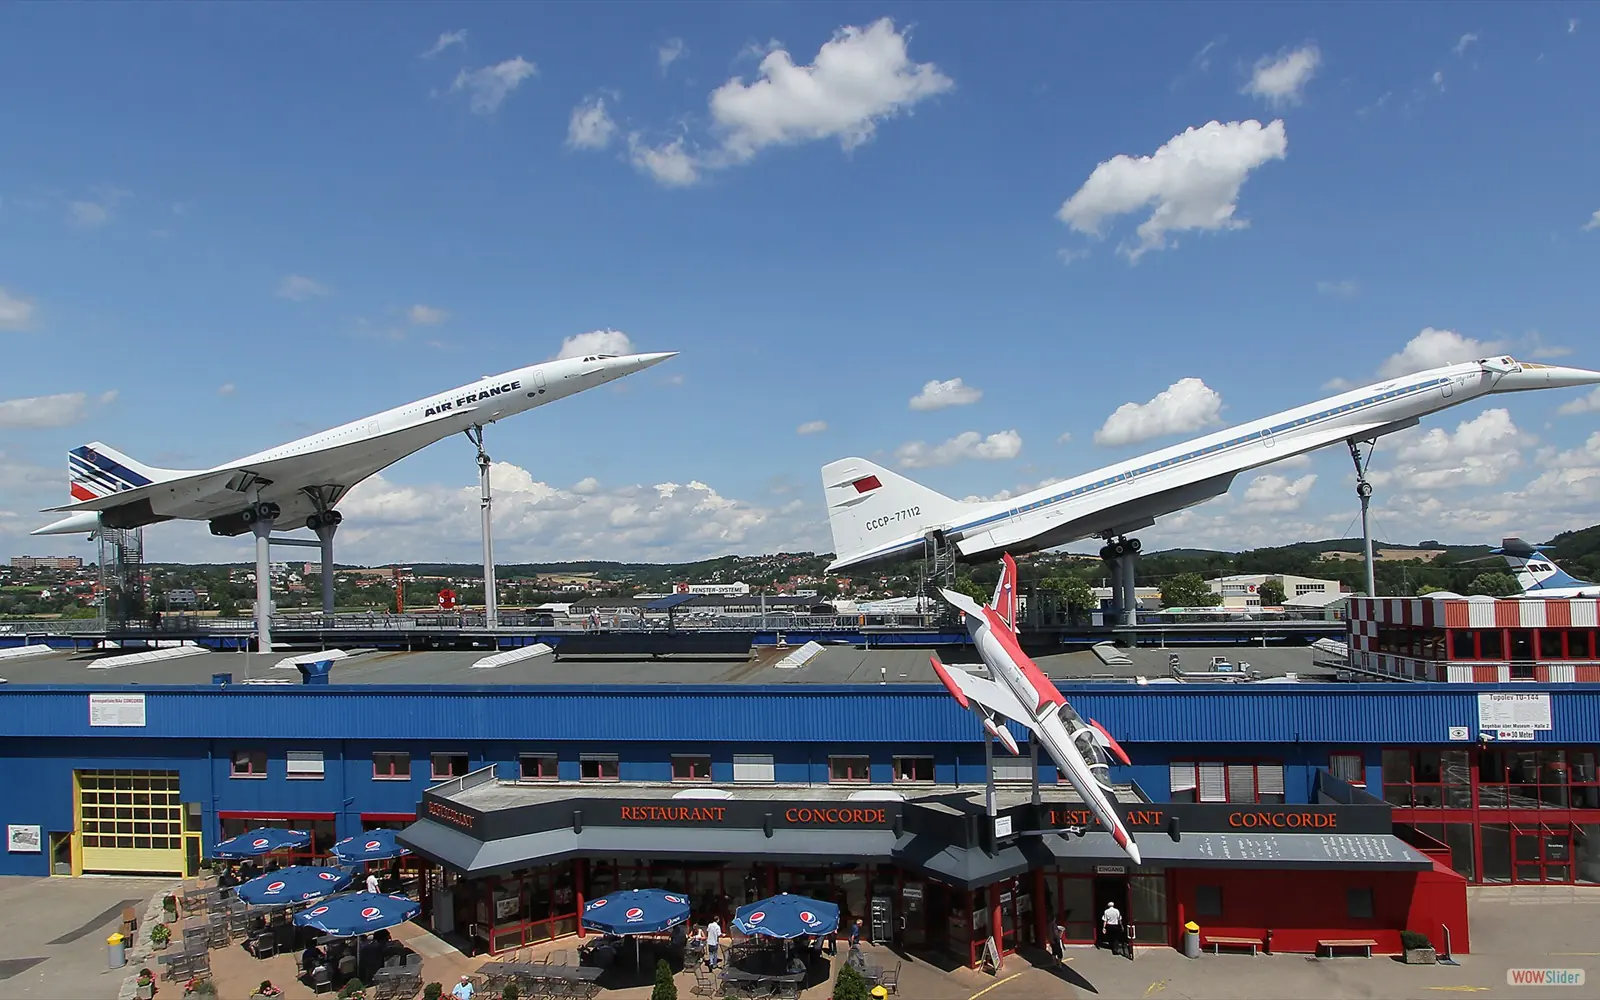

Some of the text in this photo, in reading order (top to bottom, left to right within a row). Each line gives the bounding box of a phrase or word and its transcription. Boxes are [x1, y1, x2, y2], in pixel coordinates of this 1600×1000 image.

[424, 380, 521, 417] AIR FRANCE
[1489, 694, 1514, 702] Tupolev
[620, 806, 886, 823] RESTAURANT CONCORDE
[1229, 812, 1337, 827] CONCORDE
